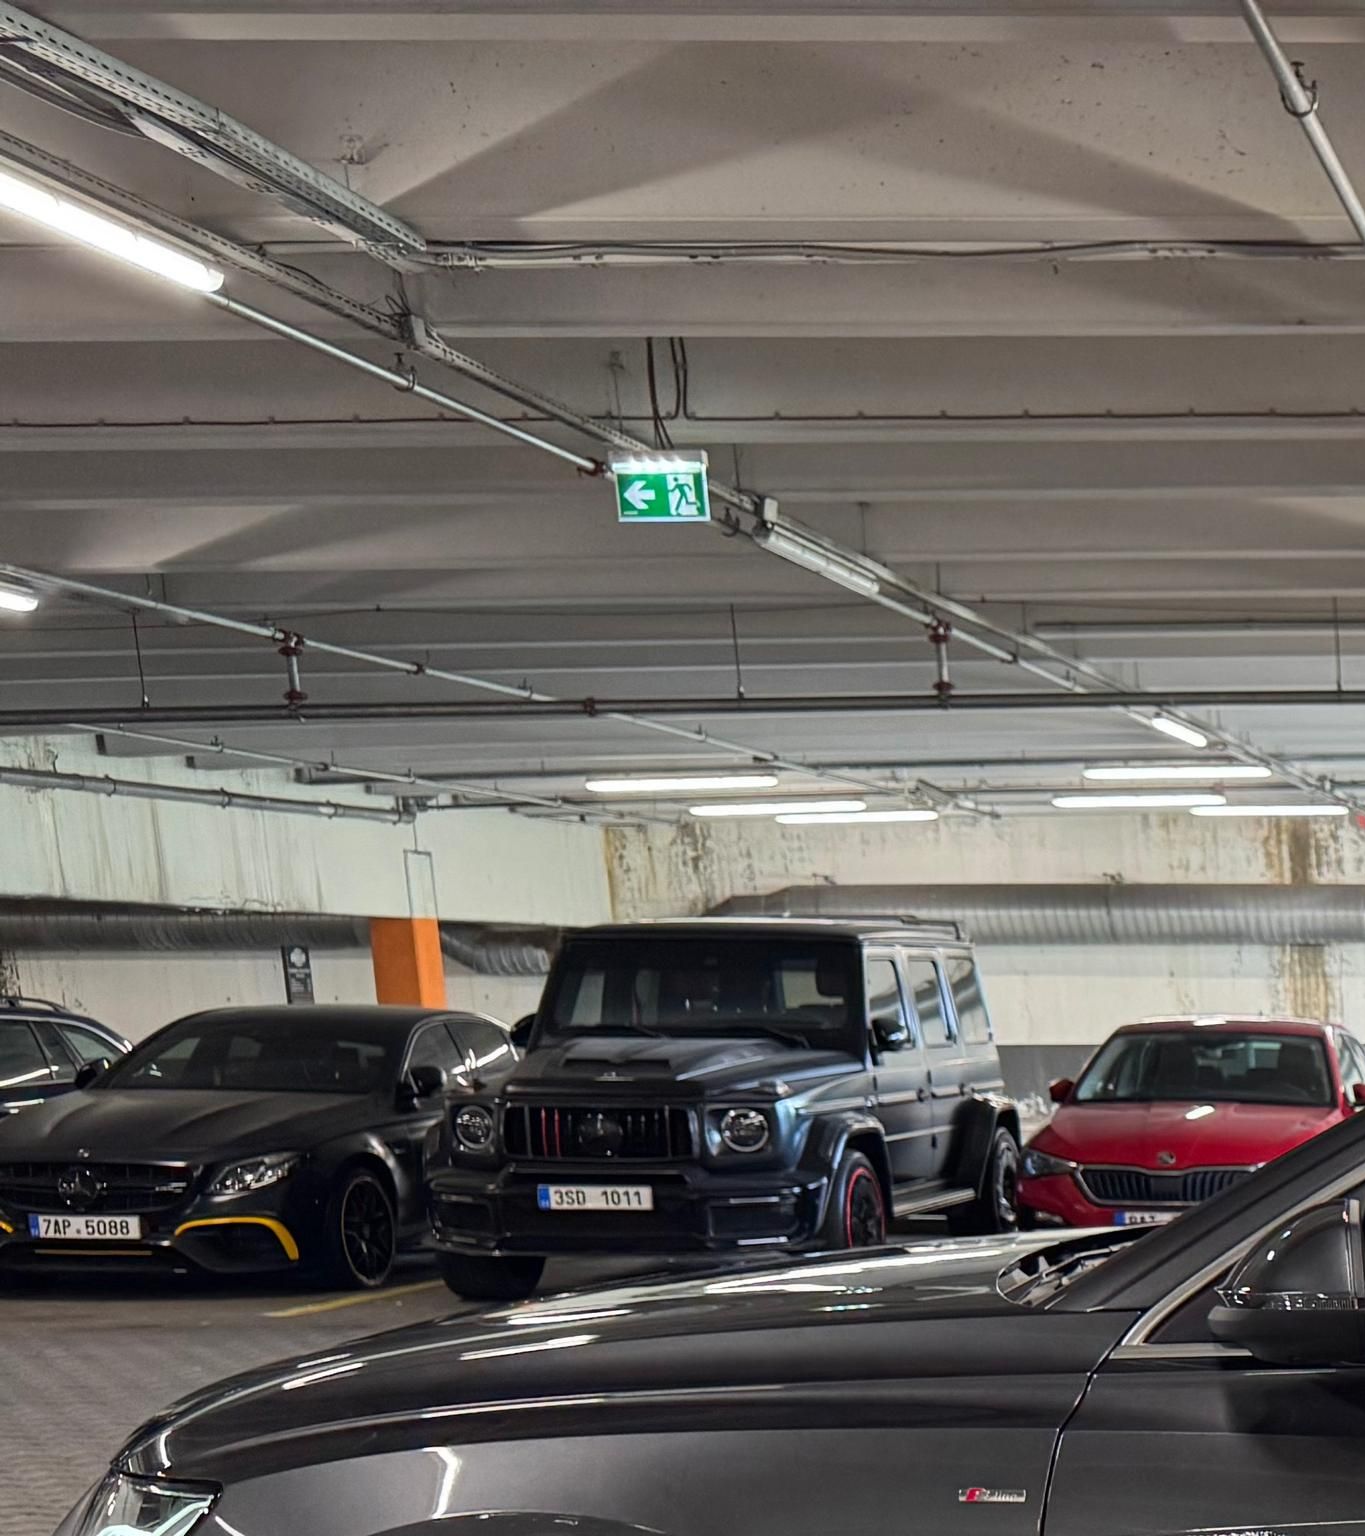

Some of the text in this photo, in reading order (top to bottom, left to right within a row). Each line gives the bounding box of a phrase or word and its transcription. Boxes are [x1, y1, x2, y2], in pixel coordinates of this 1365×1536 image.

[554, 1190, 642, 1206] 3SD 1011
[43, 1218, 130, 1236] 7AP 5088
